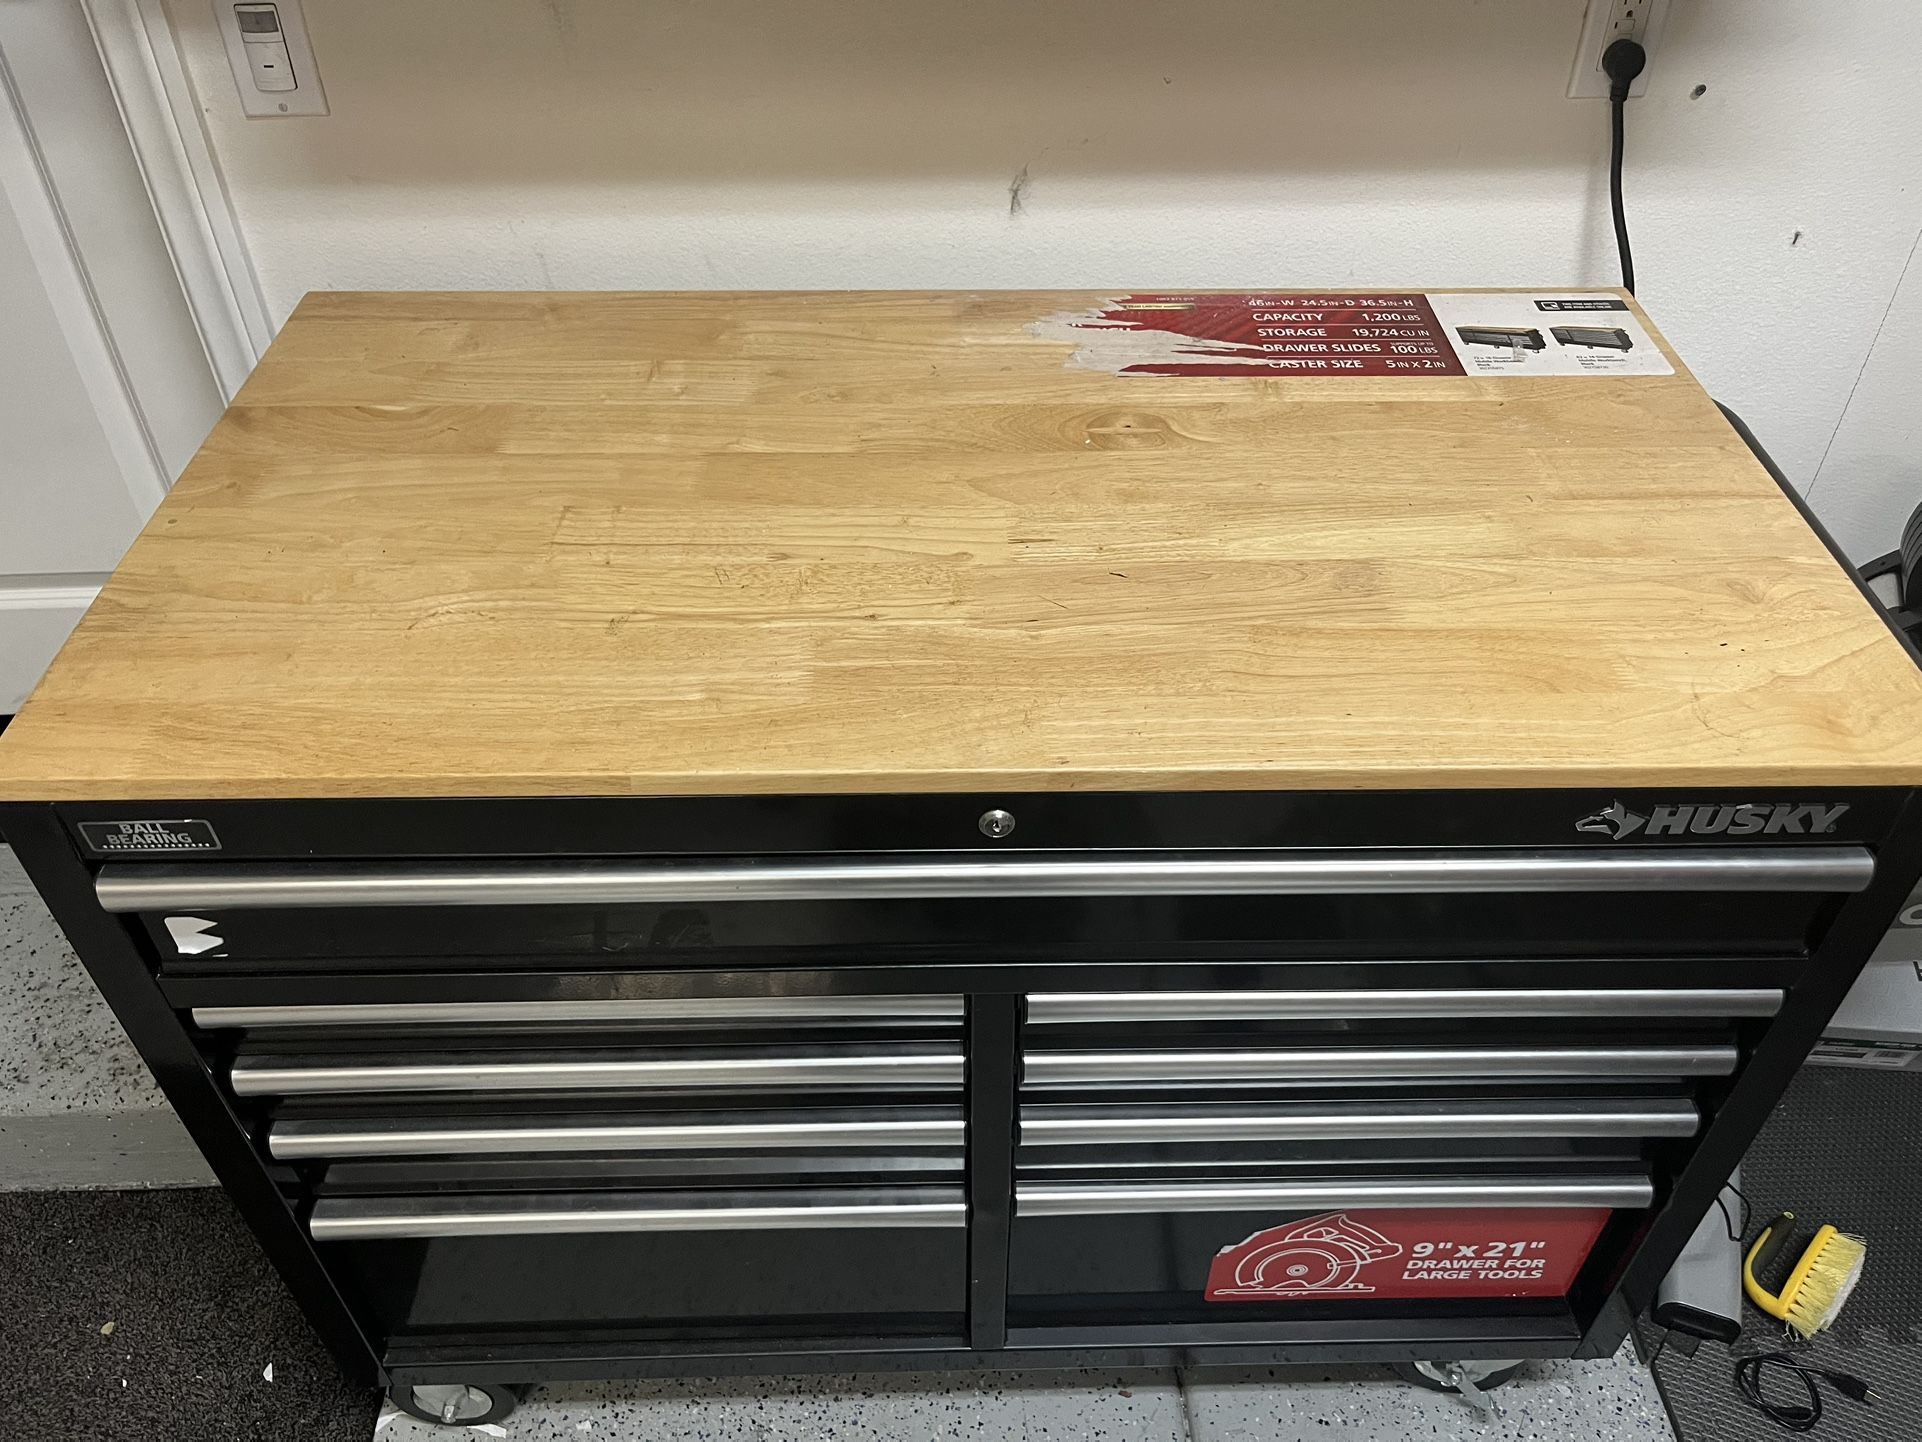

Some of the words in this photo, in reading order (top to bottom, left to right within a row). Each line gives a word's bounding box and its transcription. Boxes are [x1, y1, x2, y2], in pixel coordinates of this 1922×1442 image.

[1252, 313, 1323, 321] CAPACITY
[1362, 313, 1401, 322] 1,200
[1257, 328, 1328, 337] STORAGE
[1352, 328, 1398, 338] 19,724
[1400, 329, 1416, 337] CU
[1418, 329, 1430, 337] IN
[1262, 343, 1329, 352] DRAWER
[1331, 343, 1382, 352] SLIDES
[1390, 345, 1418, 354] 100
[1419, 346, 1438, 354] LBS
[1269, 360, 1328, 368] CASTER
[1331, 360, 1364, 368] SIZE
[1645, 804, 1850, 835] HUSKY
[118, 822, 170, 834] BALL
[106, 833, 193, 845] BEARING
[1482, 1241, 1546, 1257] 21"
[1406, 1259, 1499, 1269] DRAWER
[1503, 1259, 1546, 1268] FOR
[1402, 1270, 1471, 1280] LARGE
[1478, 1270, 1543, 1279] TOOLS
